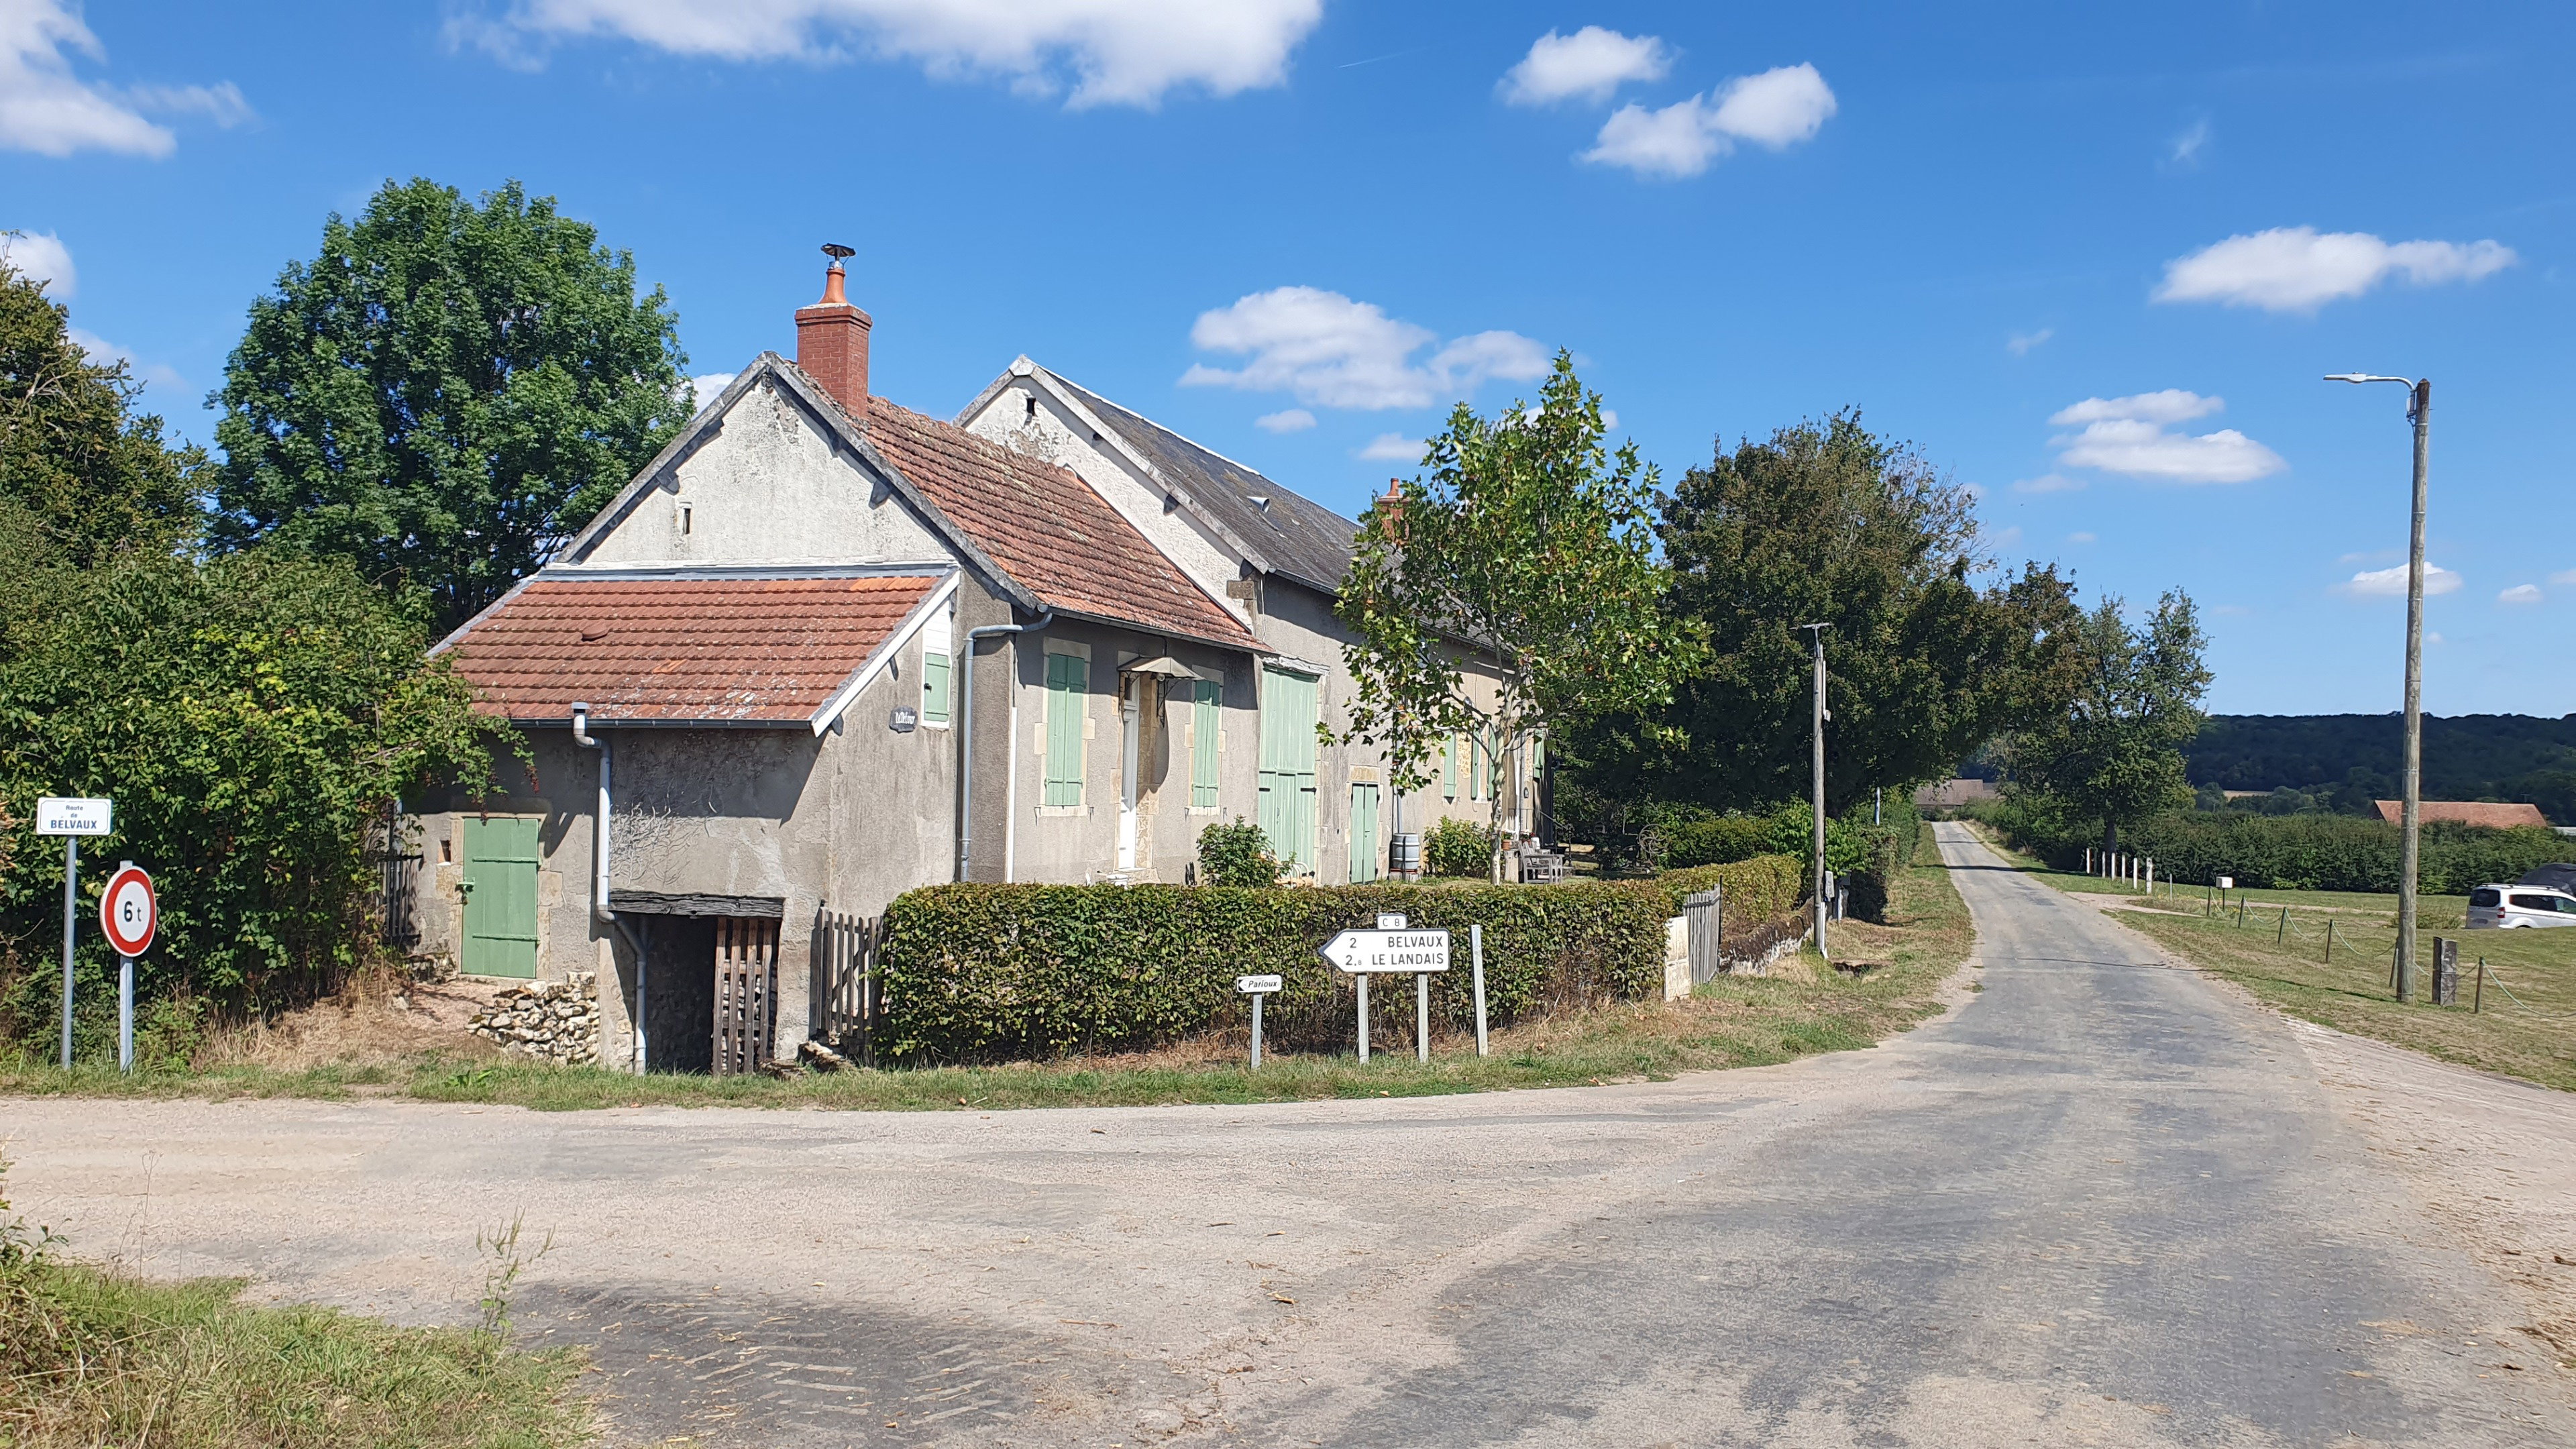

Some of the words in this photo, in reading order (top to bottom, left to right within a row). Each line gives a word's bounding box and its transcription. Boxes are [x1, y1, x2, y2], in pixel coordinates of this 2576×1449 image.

[123, 900, 133, 923] 6
[136, 906, 142, 922] t
[1382, 918, 1389, 927] C
[1394, 918, 1400, 927] 8
[1349, 937, 1357, 949] 2
[1387, 935, 1443, 948] BELVAUX
[1372, 953, 1386, 965] LE
[1391, 953, 1444, 965] LANDAIS
[1248, 979, 1278, 988] Parioux
